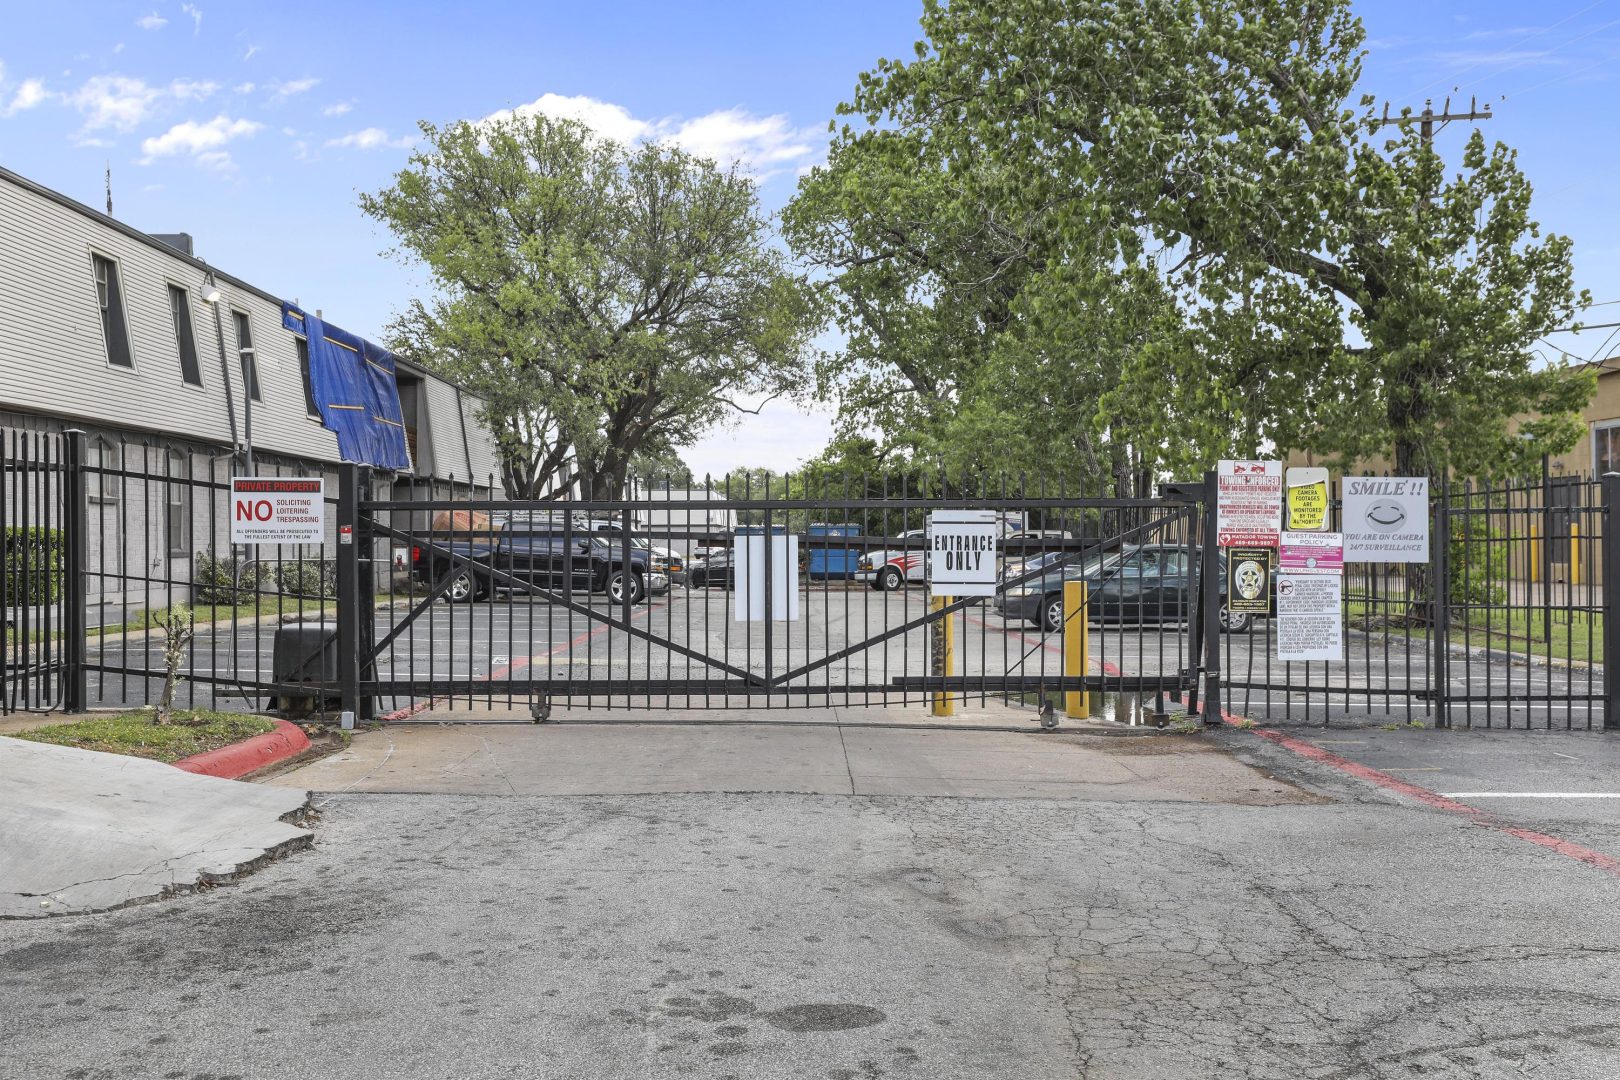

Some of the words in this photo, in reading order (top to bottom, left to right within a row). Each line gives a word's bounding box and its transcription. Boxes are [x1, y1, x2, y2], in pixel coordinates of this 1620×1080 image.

[235, 482, 272, 491] PRIVATE
[274, 482, 320, 492] PROPERTY
[1221, 476, 1246, 485] TOWING
[236, 500, 273, 521] NO
[934, 535, 993, 551] ENTRANCE
[946, 551, 981, 571] ONLY
